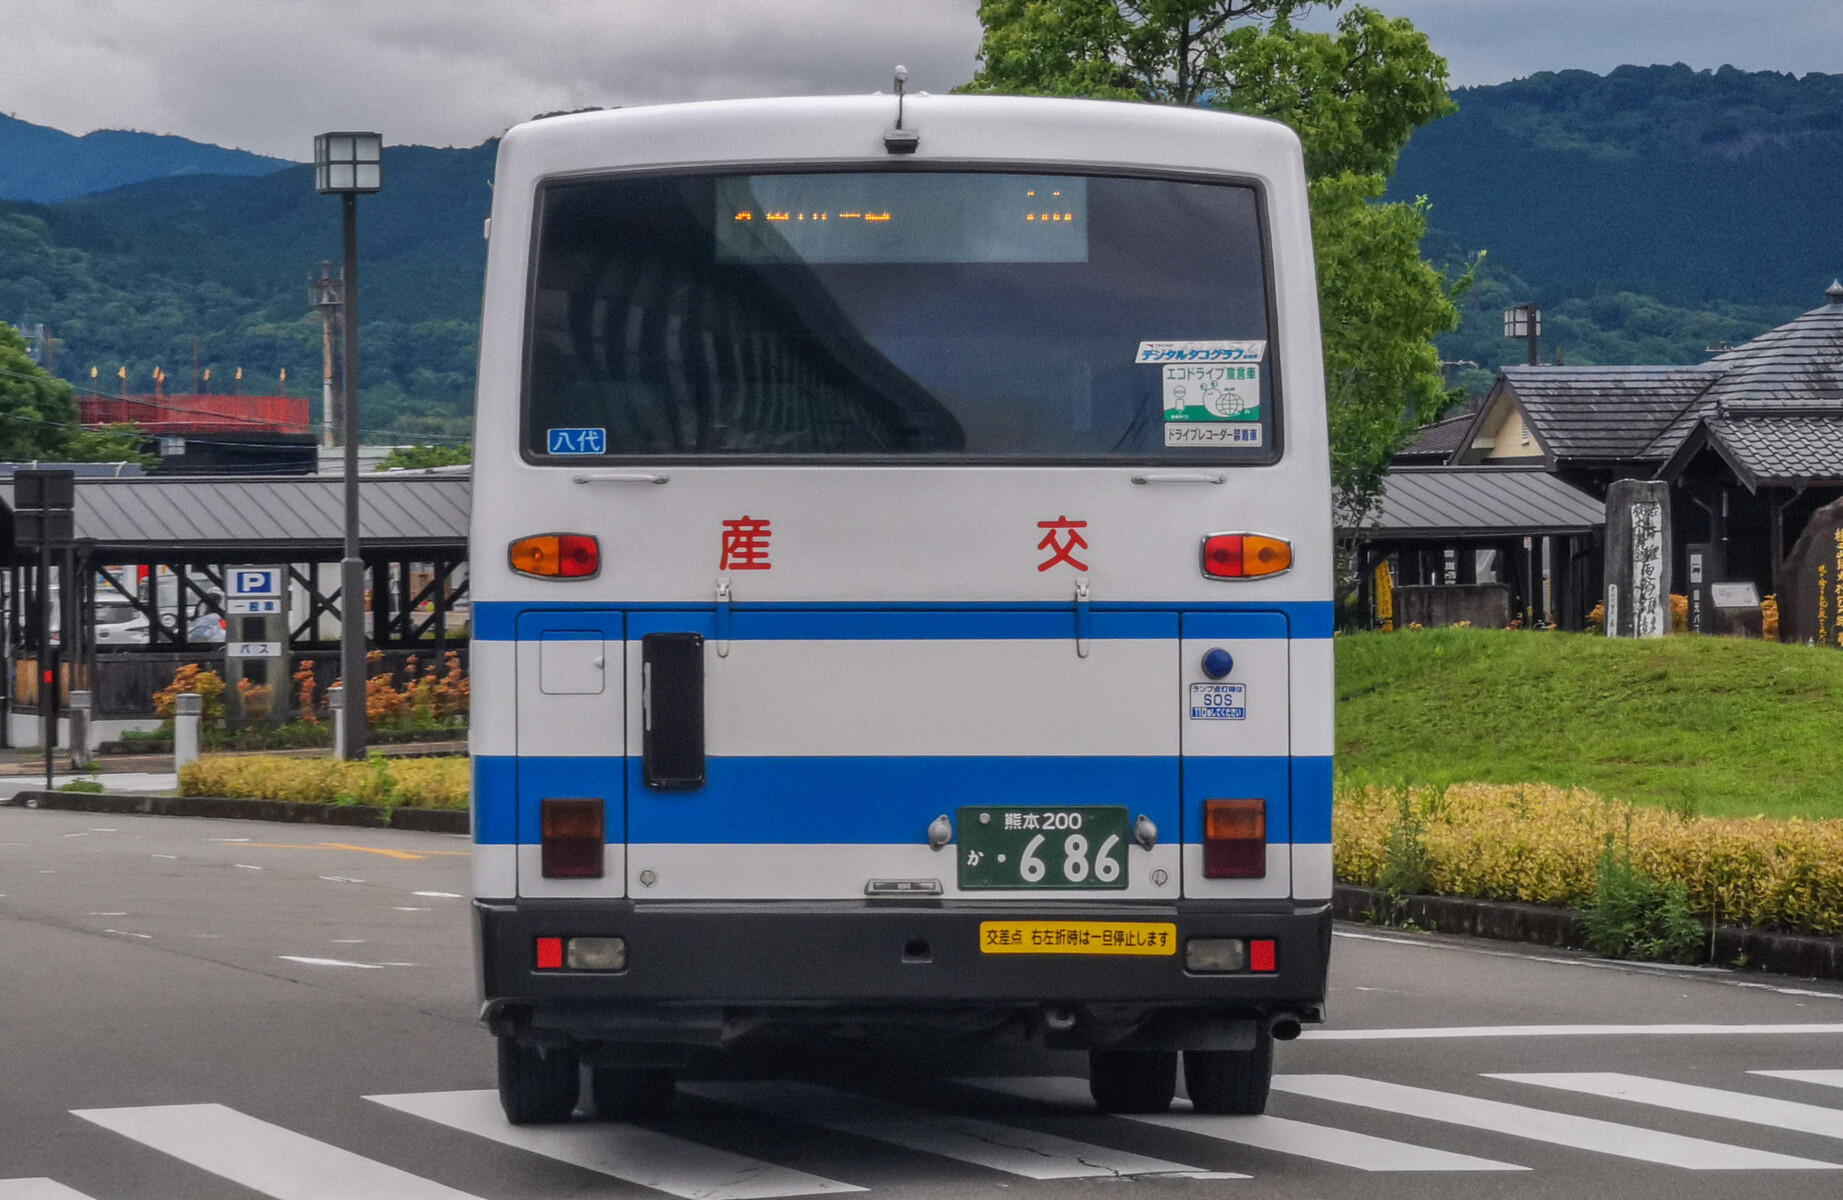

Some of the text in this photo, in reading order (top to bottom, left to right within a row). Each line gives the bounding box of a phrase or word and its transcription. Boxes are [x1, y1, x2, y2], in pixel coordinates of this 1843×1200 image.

[552, 431, 600, 451] 八代
[719, 515, 1088, 572] 産 交
[243, 573, 265, 592] P
[241, 644, 269, 654] バス
[1204, 694, 1232, 706] SOS
[986, 929, 1169, 947] 交差点 右左折時は一旦停止します
